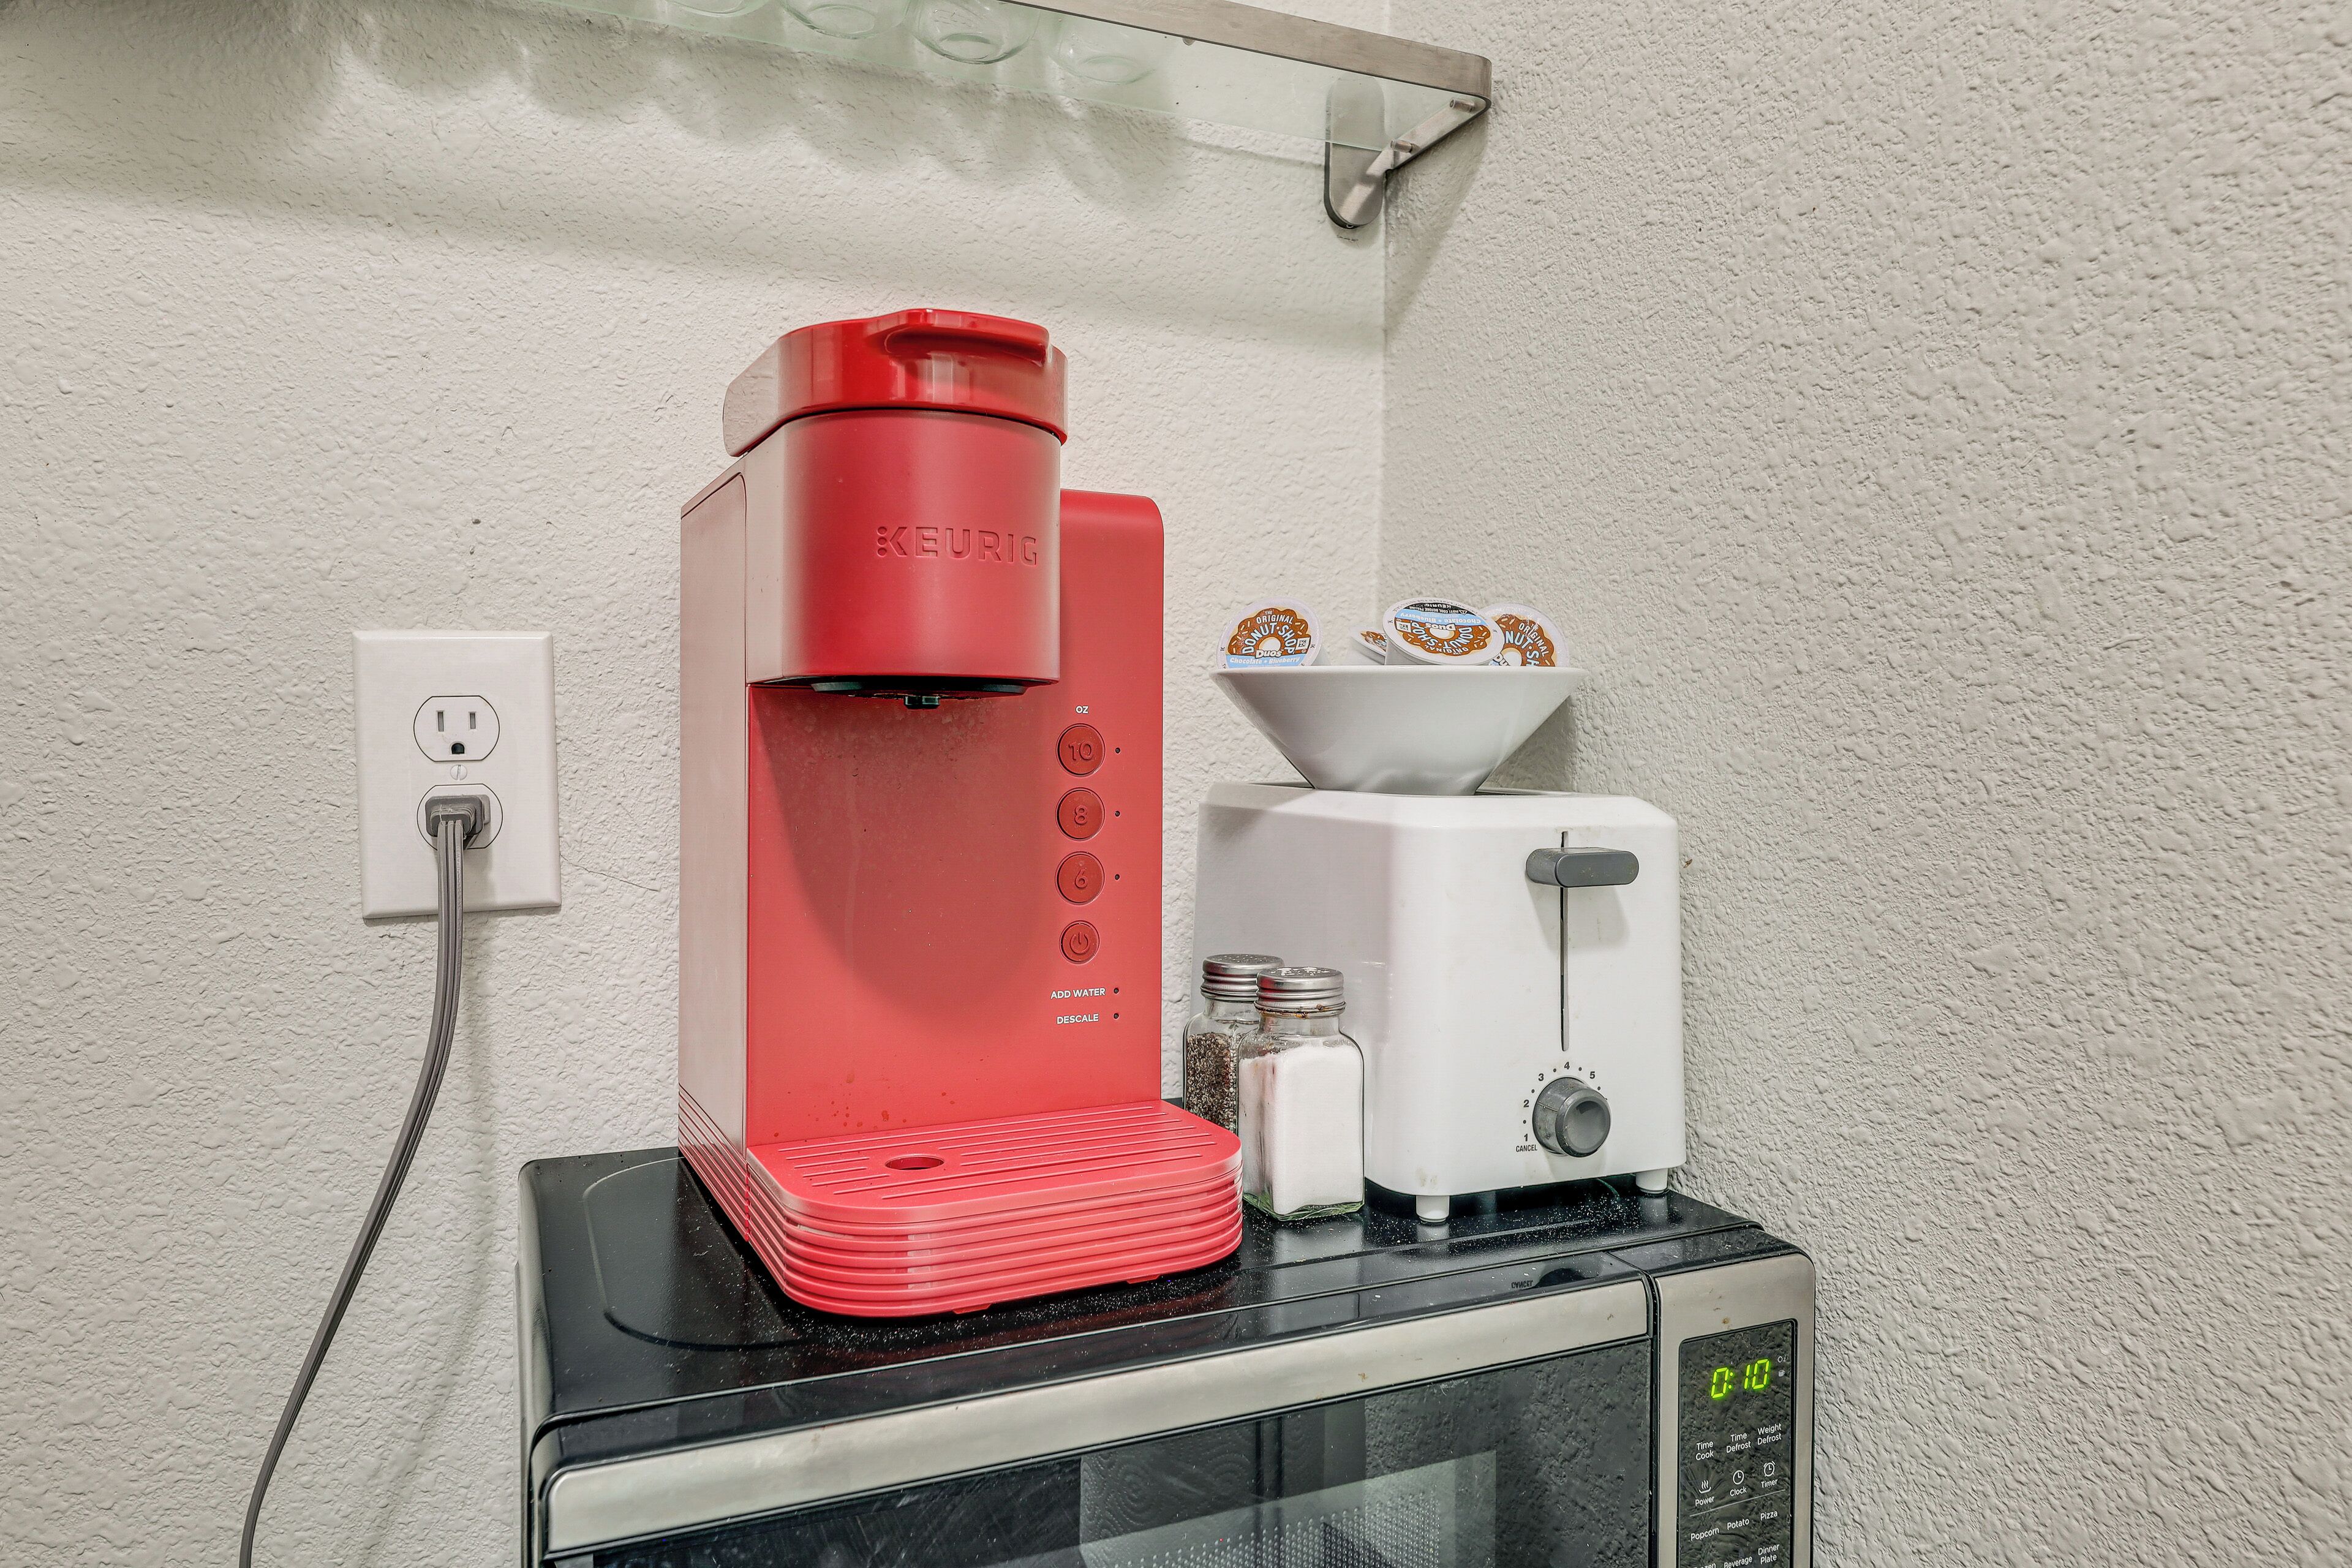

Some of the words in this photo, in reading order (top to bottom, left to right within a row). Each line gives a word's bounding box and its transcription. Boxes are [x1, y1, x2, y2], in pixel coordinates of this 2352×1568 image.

[876, 526, 1038, 567] KEURIG
[1256, 614, 1294, 625] ORIGINAL
[1400, 612, 1436, 623] Blueberry
[1242, 622, 1277, 654] DONUT
[1443, 627, 1474, 649] DONUT
[1505, 630, 1534, 649] NUT
[1518, 622, 1550, 657] ORIGINAL
[1425, 644, 1469, 654] ORIGINAL
[1068, 740, 1095, 761] 10
[1073, 805, 1088, 824] 8
[1073, 869, 1088, 889] 6
[1050, 990, 1071, 999] ADD
[1072, 987, 1106, 998] WATER
[1057, 1013, 1099, 1025] DESCALE
[1711, 1358, 1770, 1398] 0:10
[1757, 1423, 1782, 1435] Weight
[1730, 1432, 1747, 1442] Time
[1757, 1433, 1782, 1446] Defrost
[1696, 1441, 1714, 1451] Time
[1726, 1441, 1751, 1453] Defrost
[1695, 1450, 1714, 1461] Cook
[1761, 1479, 1778, 1488] Timer
[1730, 1486, 1747, 1496] Clock
[1695, 1496, 1715, 1507] Power
[1760, 1510, 1778, 1521] Pizza
[1727, 1518, 1750, 1530] Potato
[1691, 1527, 1719, 1541] Popcorn
[1758, 1544, 1780, 1556] Dinner
[1724, 1556, 1753, 1568] Beverage
[1760, 1554, 1777, 1565] Plate
